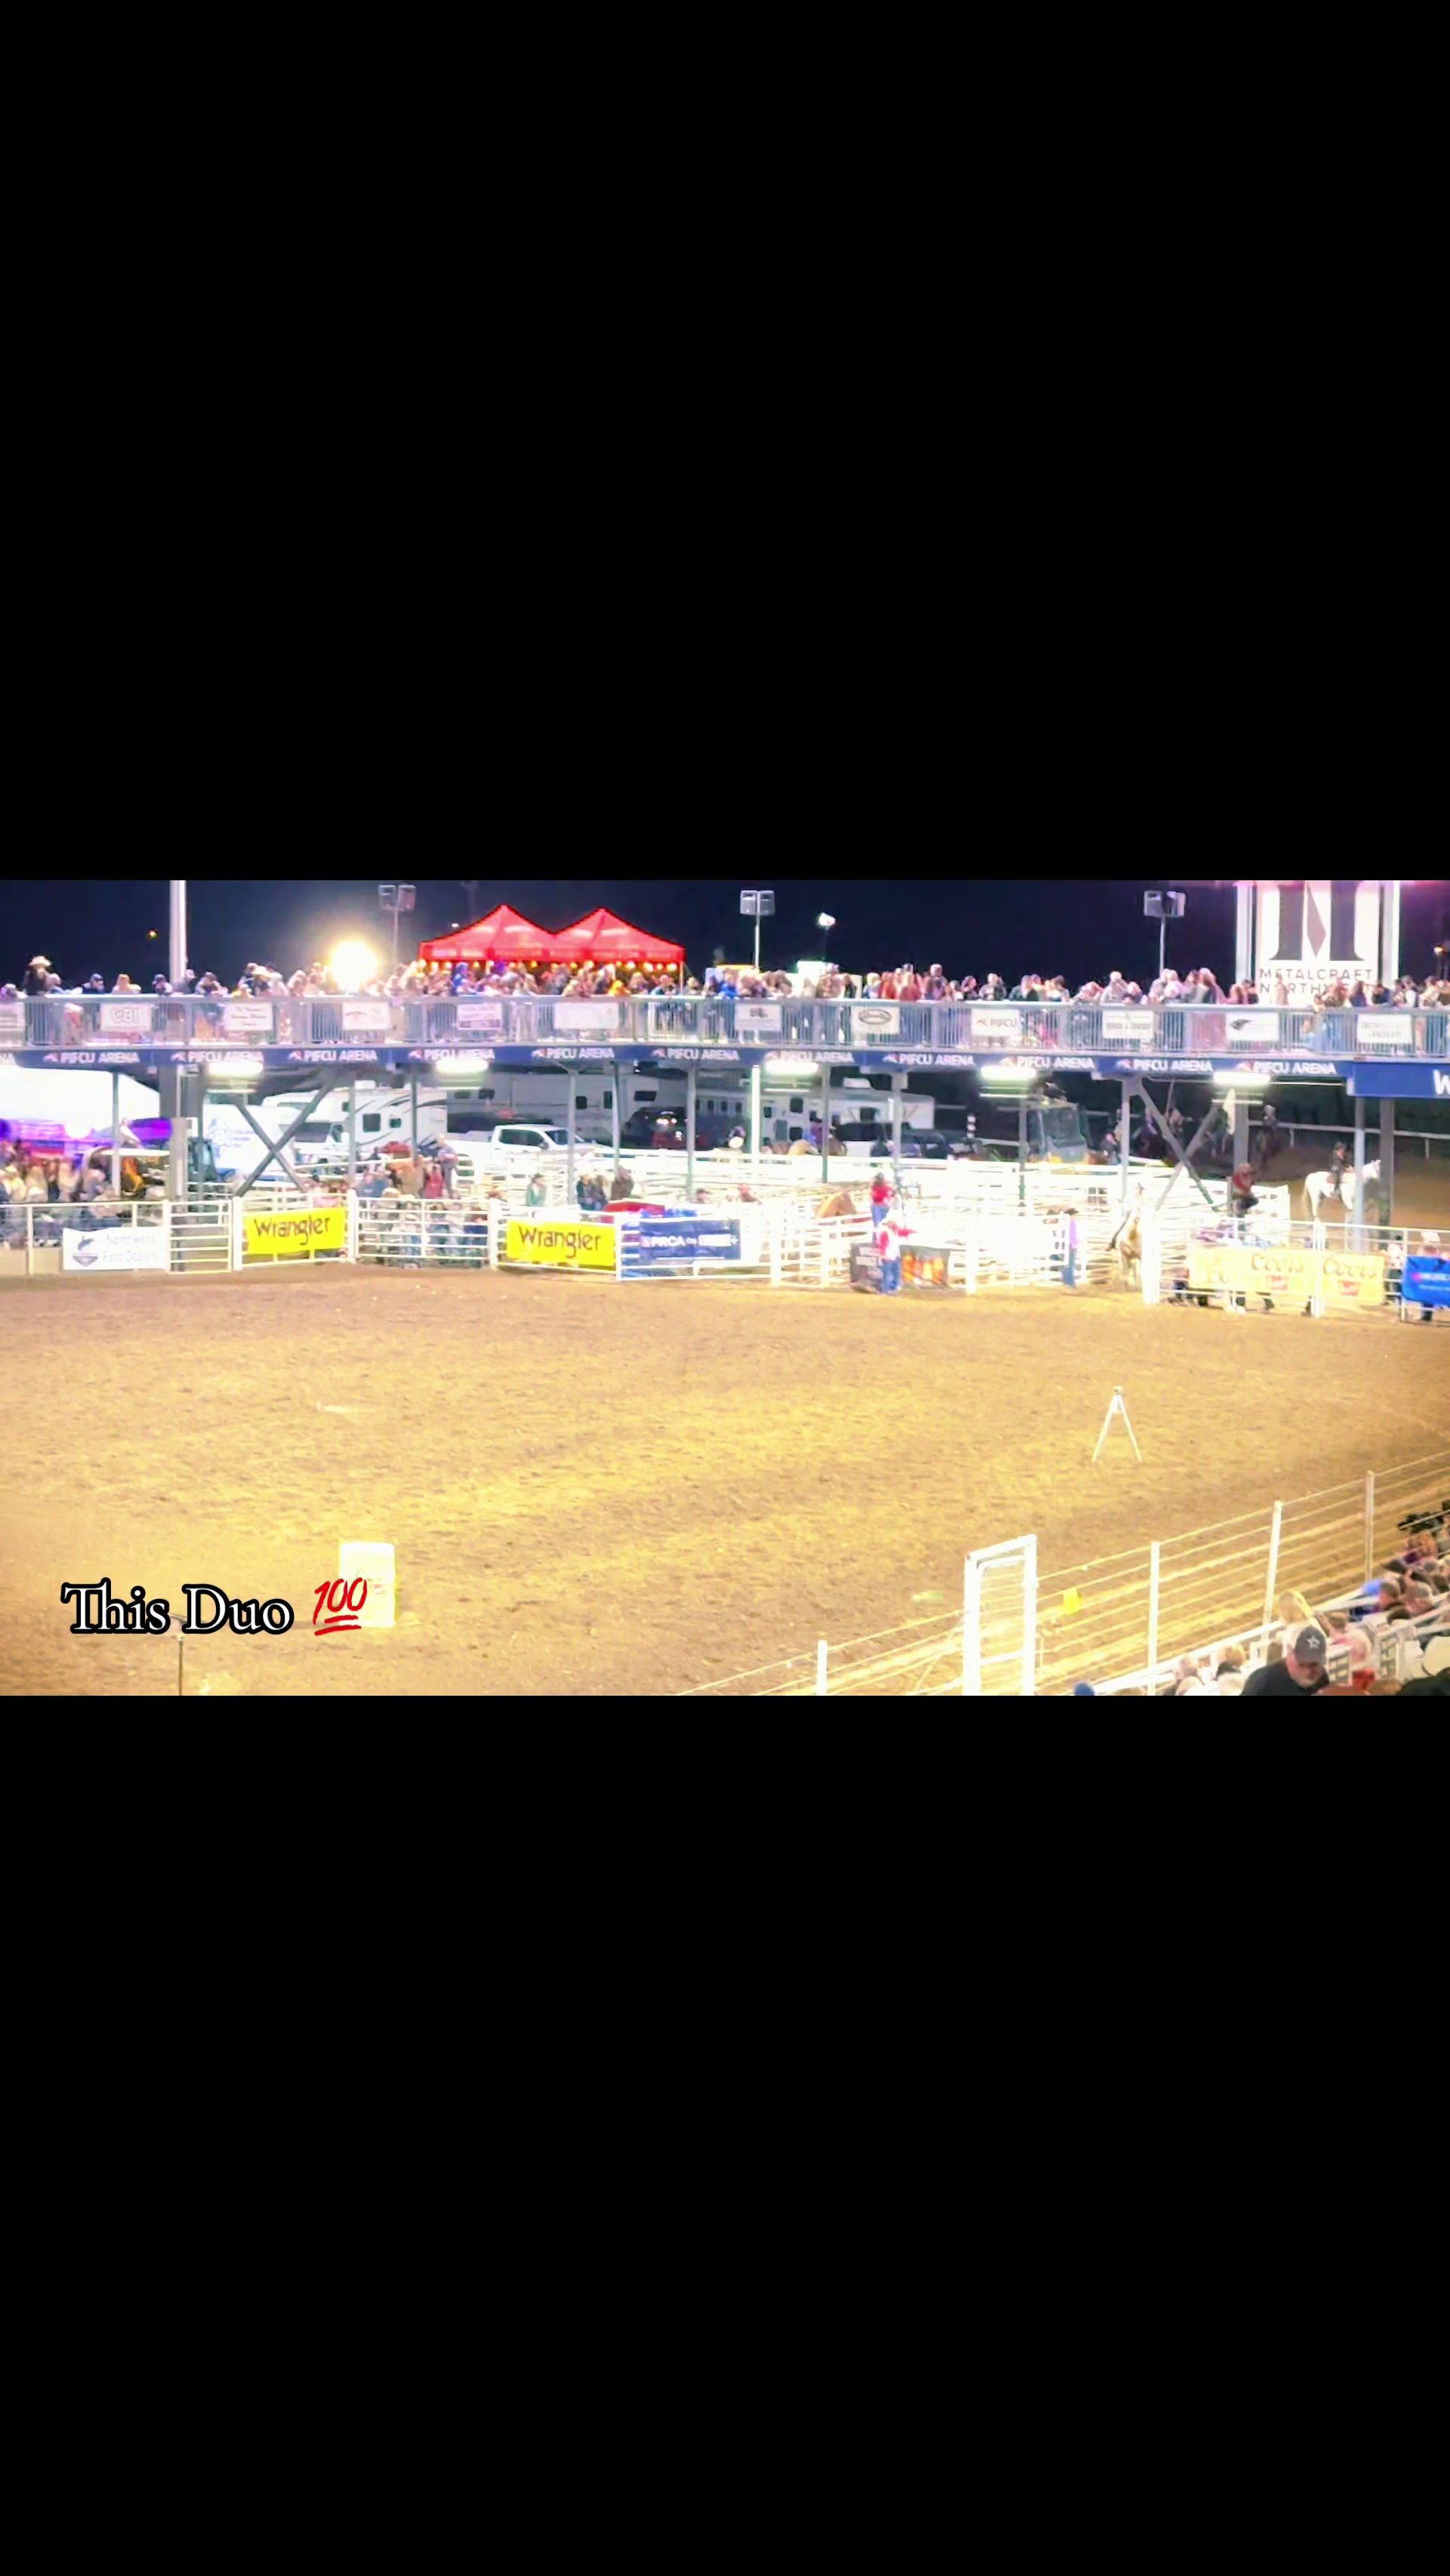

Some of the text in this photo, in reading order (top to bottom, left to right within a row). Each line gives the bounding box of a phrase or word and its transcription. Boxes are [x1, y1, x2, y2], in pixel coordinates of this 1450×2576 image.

[99, 1052, 140, 1063] ARENA
[304, 1050, 378, 1062] PIFCU ARENA
[547, 1047, 615, 1058] PIFCU ARENA
[667, 1049, 740, 1061] PIFCU ARENA
[899, 1053, 976, 1065] PIFCU ARENA
[1134, 1058, 1213, 1071] PIFCU ARENA
[1254, 1061, 1337, 1074] PIFCU ARENA
[255, 1215, 331, 1246] Wrangler
[519, 1225, 601, 1259] Wrangler
